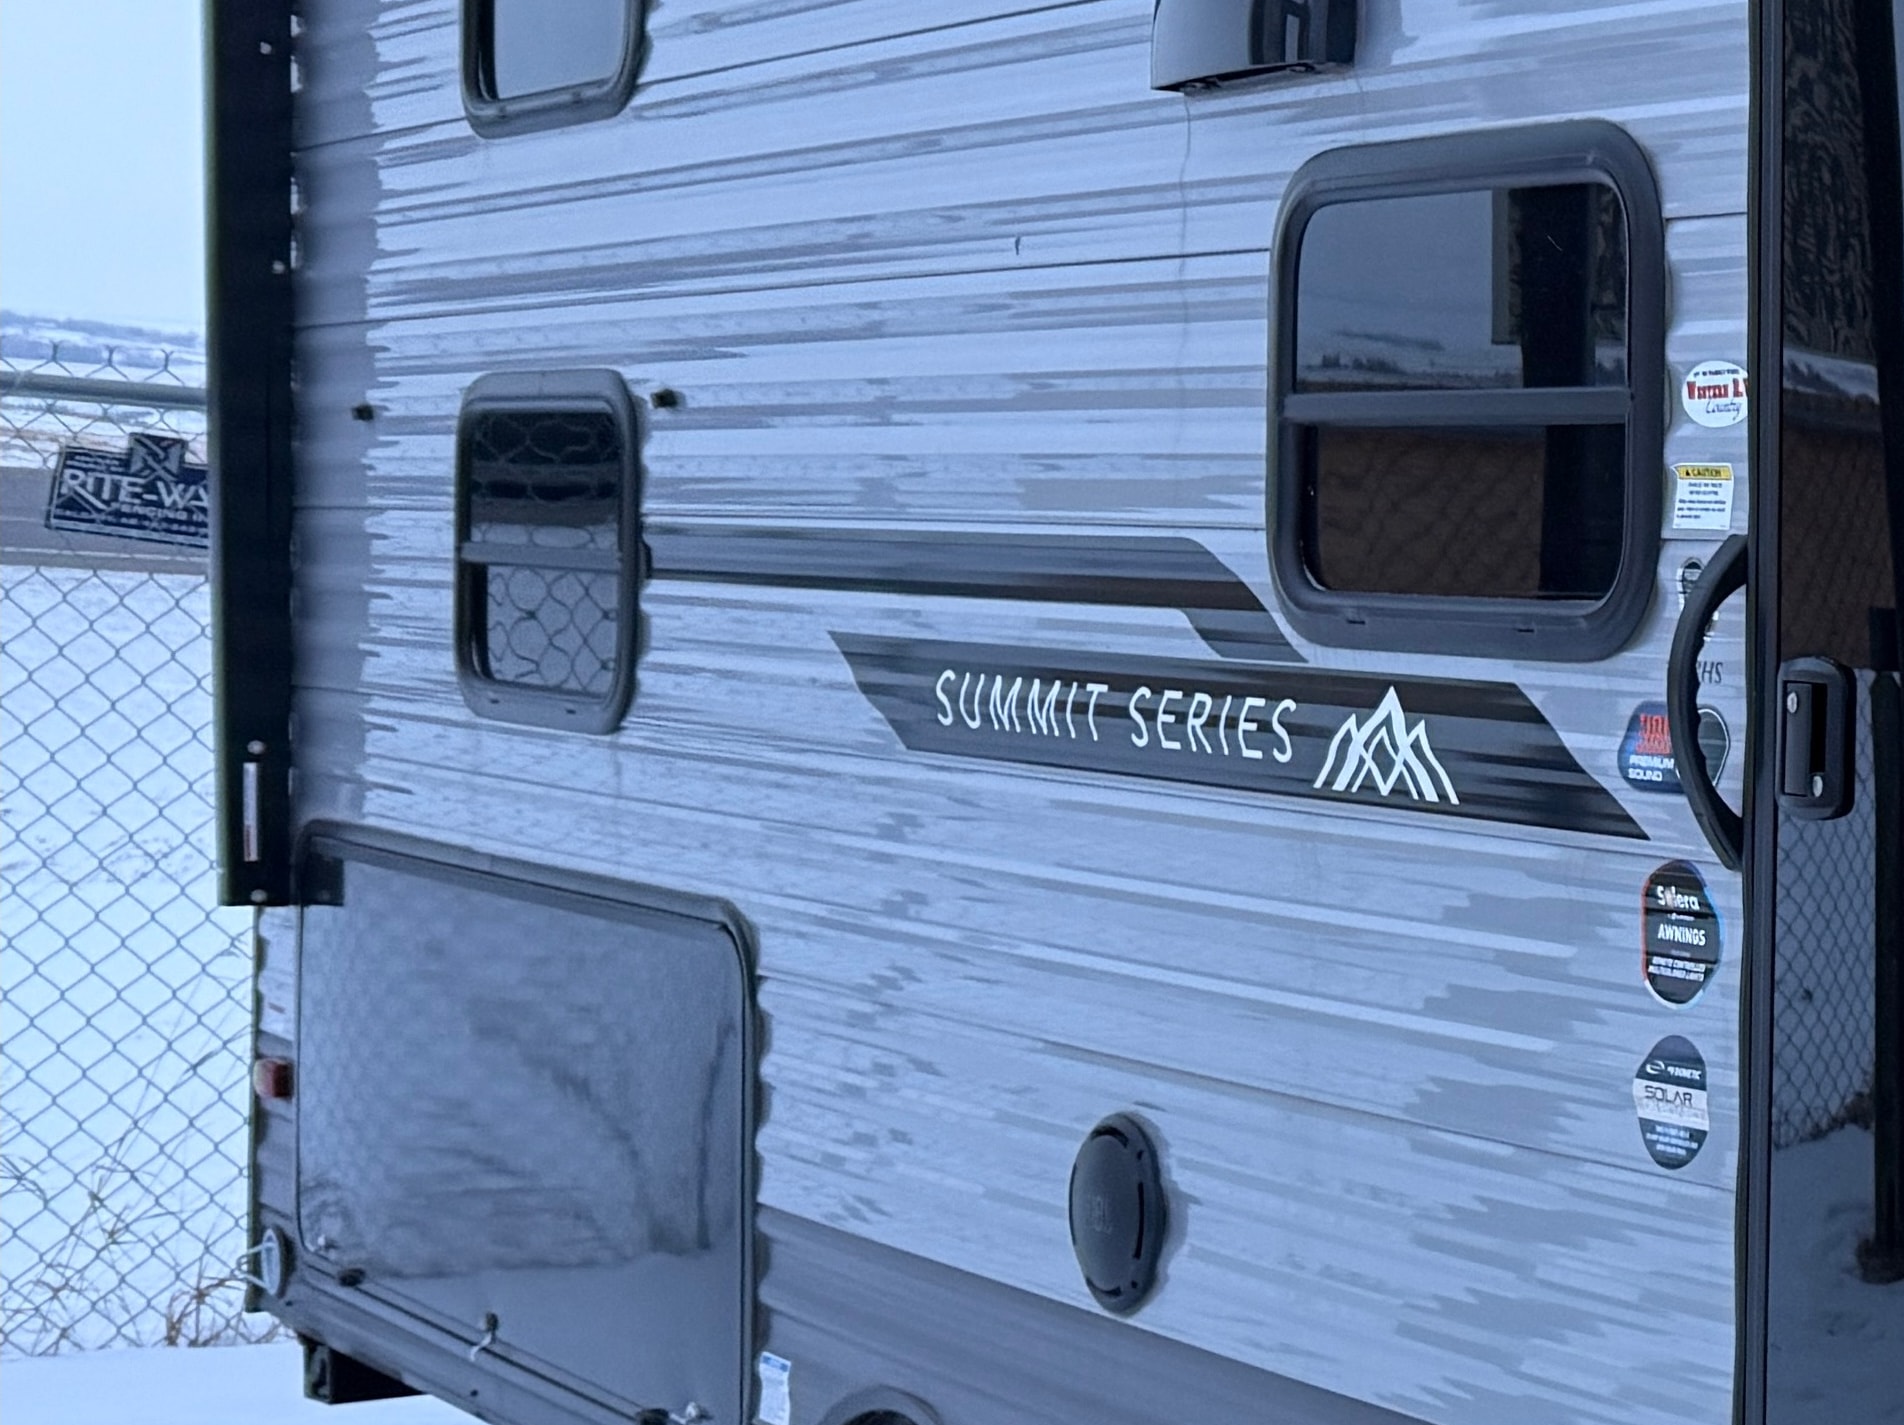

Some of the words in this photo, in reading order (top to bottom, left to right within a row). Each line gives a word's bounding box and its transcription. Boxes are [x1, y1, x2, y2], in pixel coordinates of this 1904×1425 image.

[61, 468, 208, 509] RITE-WA
[935, 669, 1109, 741] SUMMIT
[1128, 686, 1297, 763] SERIES
[1629, 754, 1675, 770] PREMIUM
[1628, 769, 1663, 781] SOUND
[1656, 885, 1701, 911] Solera
[1657, 923, 1706, 947] AWNINGS
[1644, 1085, 1693, 1108] SOLAR
